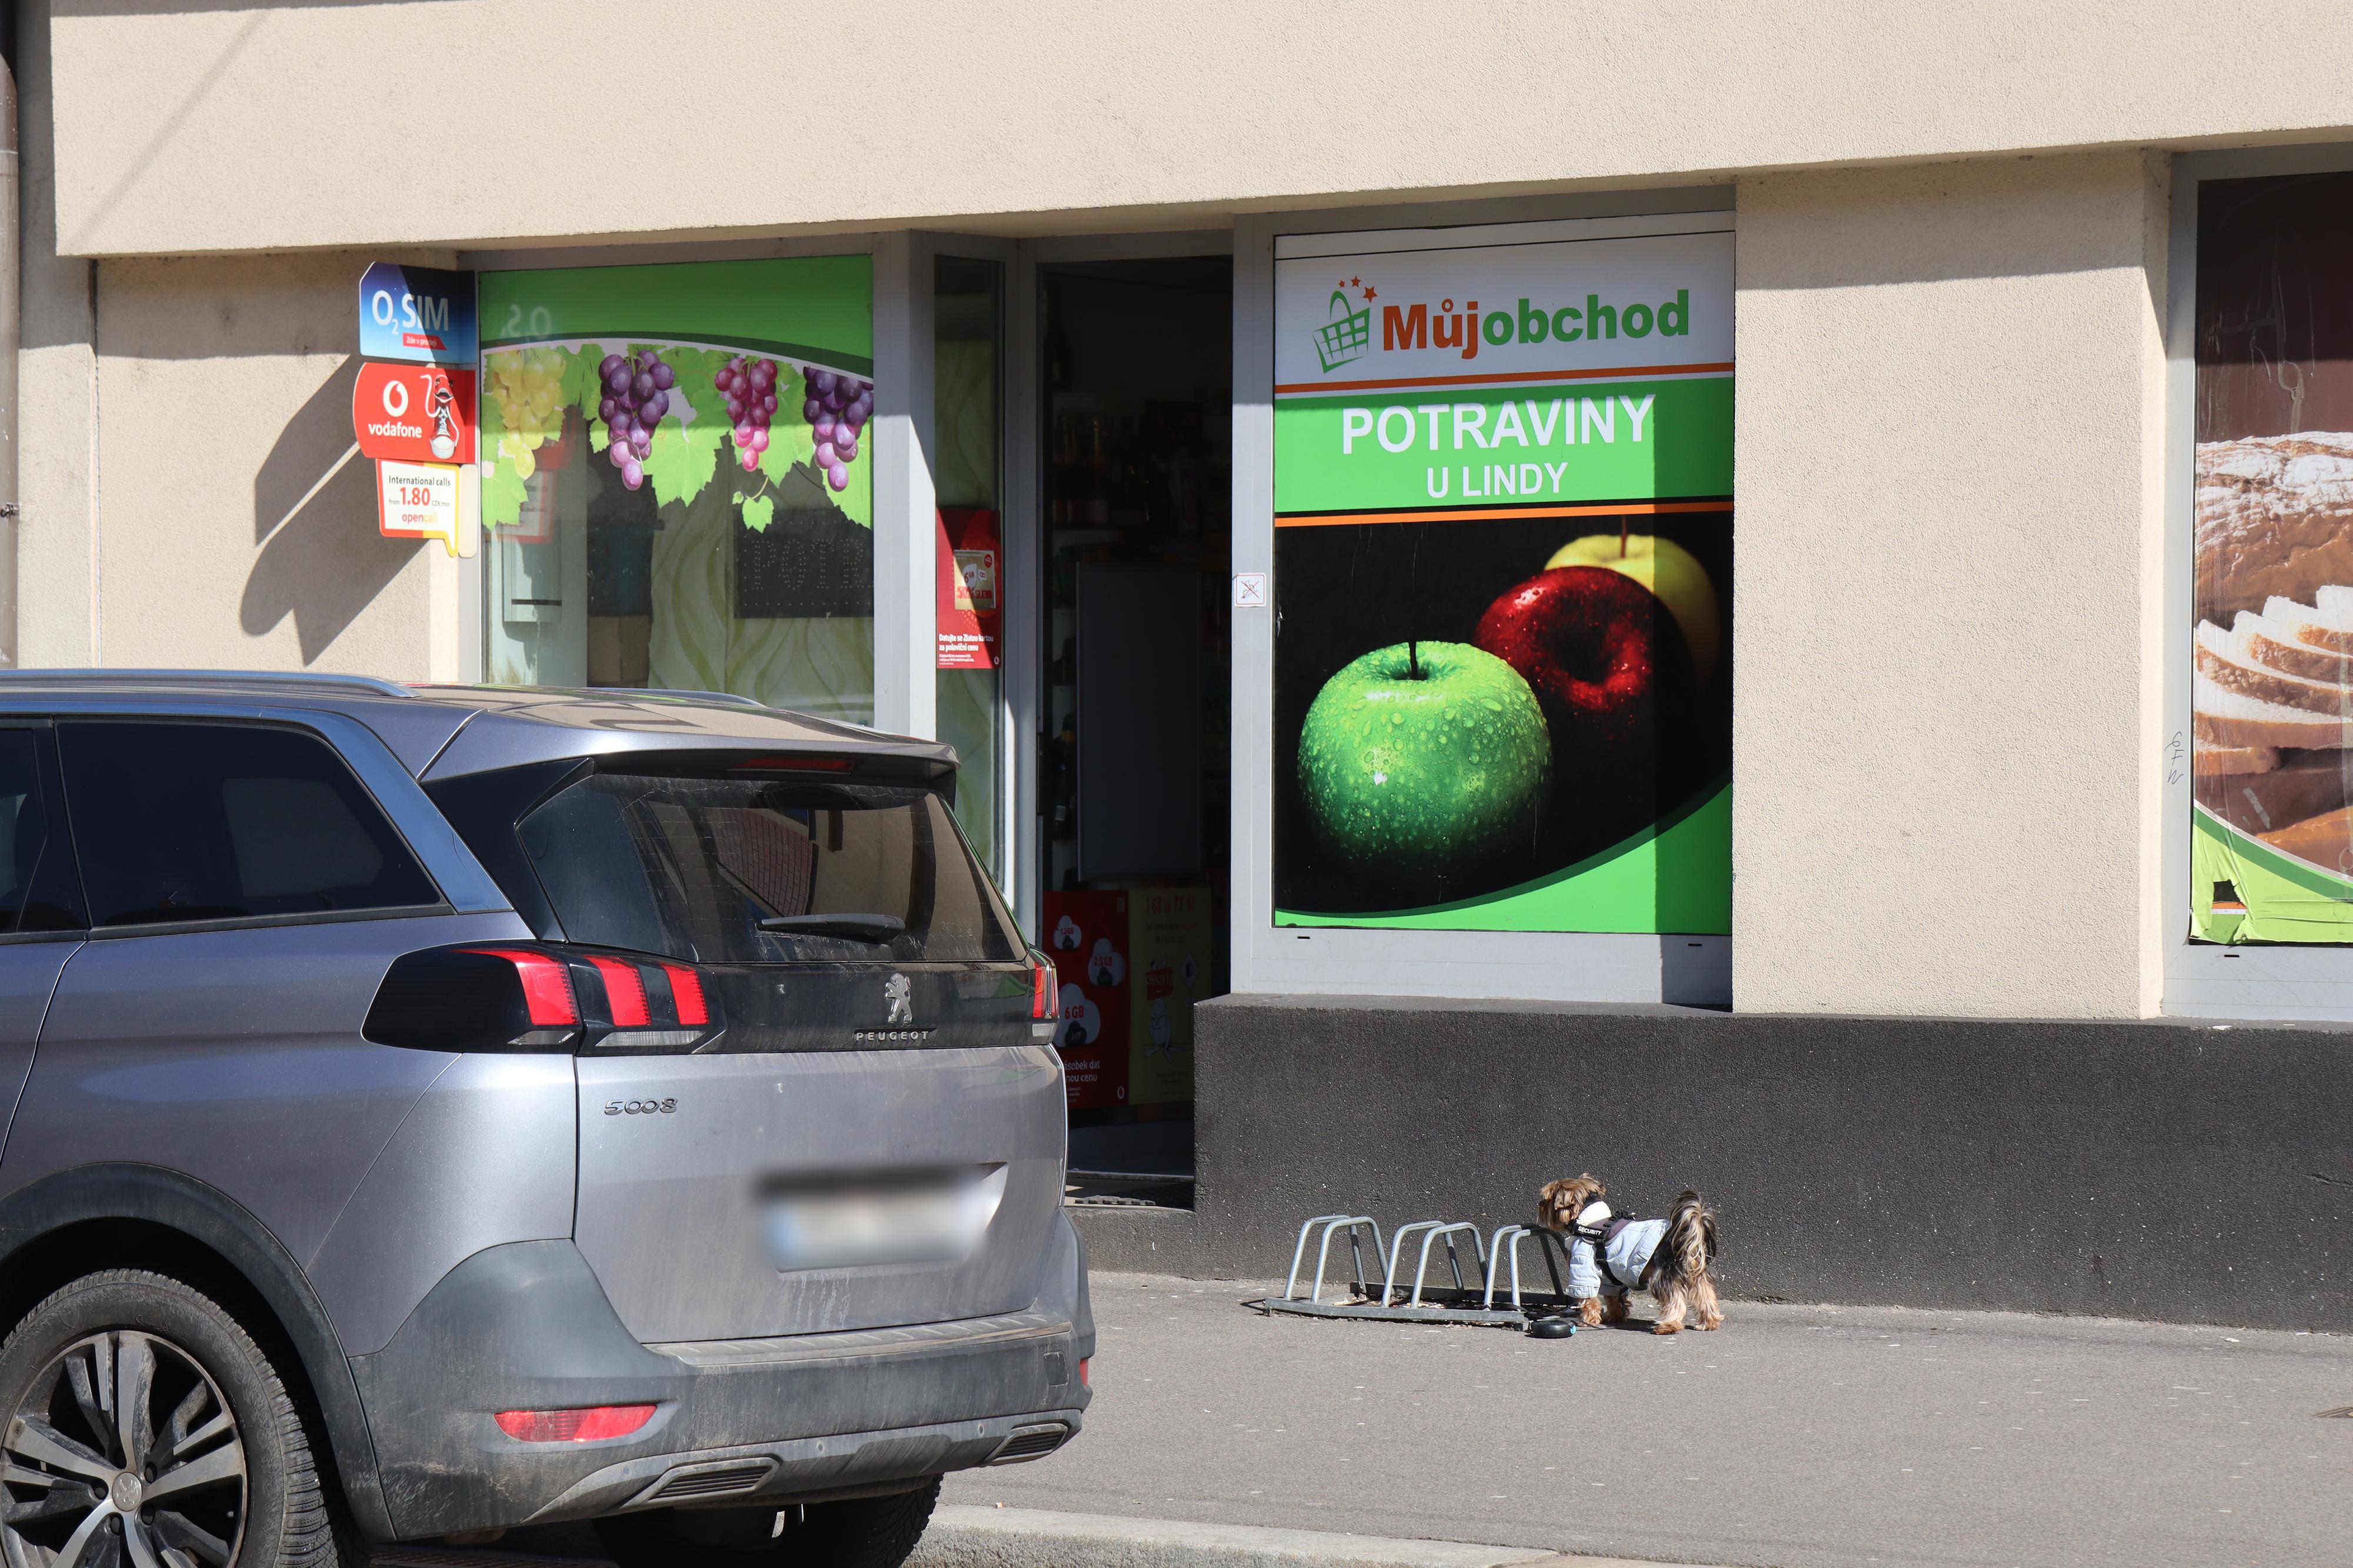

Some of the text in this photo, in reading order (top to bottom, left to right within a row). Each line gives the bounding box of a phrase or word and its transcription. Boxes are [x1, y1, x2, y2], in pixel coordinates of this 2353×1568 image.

[402, 293, 449, 332] SIM
[406, 336, 415, 344] Zde
[368, 421, 422, 439] vodafone
[1341, 393, 1656, 455] POTRAVINY
[389, 475, 451, 486] International calls
[1427, 461, 1569, 499] U LINDY
[400, 486, 431, 506] 1.80
[978, 633, 994, 642] kartou
[1065, 1005, 1084, 1020] 6 GB
[856, 1030, 929, 1042] PEUGEOT
[1089, 1059, 1101, 1070] dat
[1080, 1073, 1097, 1083] cenu
[604, 1097, 678, 1116] 5008
[1577, 1226, 1602, 1236] SECURITY
